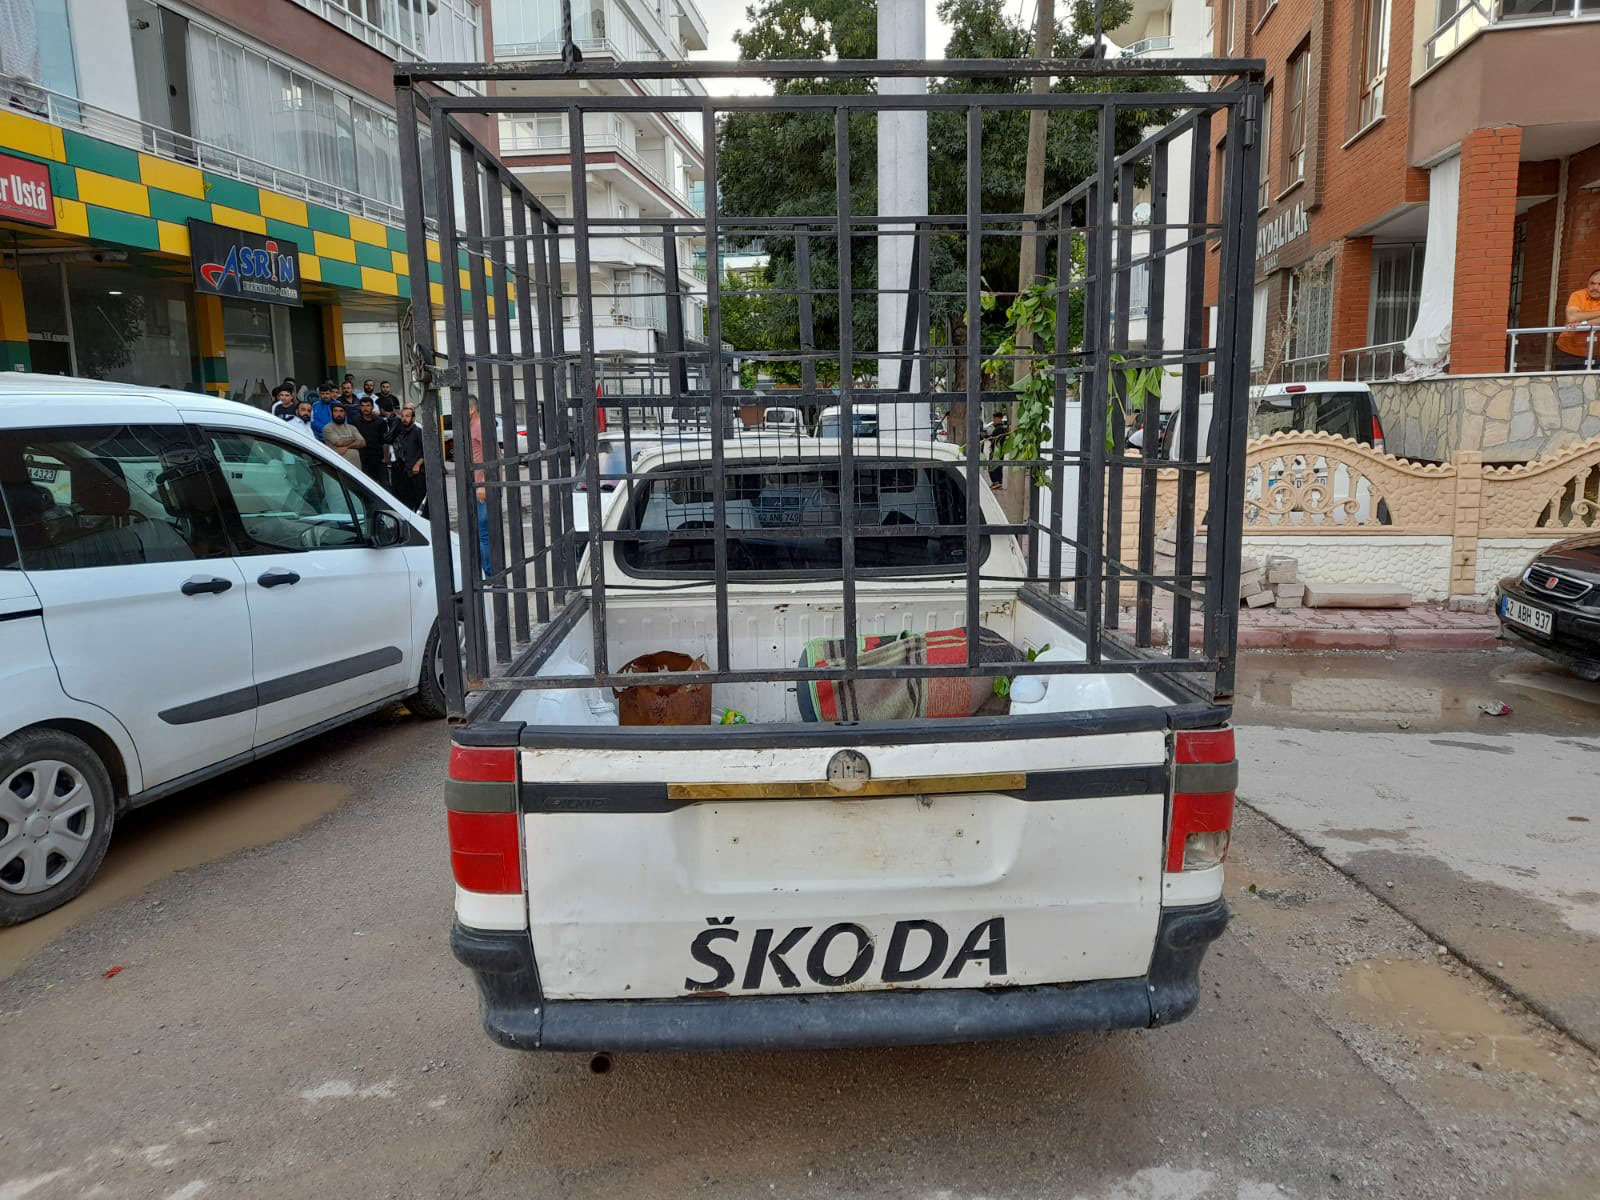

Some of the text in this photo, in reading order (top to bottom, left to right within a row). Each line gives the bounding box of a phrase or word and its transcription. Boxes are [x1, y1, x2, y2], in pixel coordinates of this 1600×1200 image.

[10, 174, 47, 210] Usta
[1517, 604, 1532, 624] ABH
[1534, 610, 1550, 631] 937
[684, 916, 1008, 991] ŠKODA
